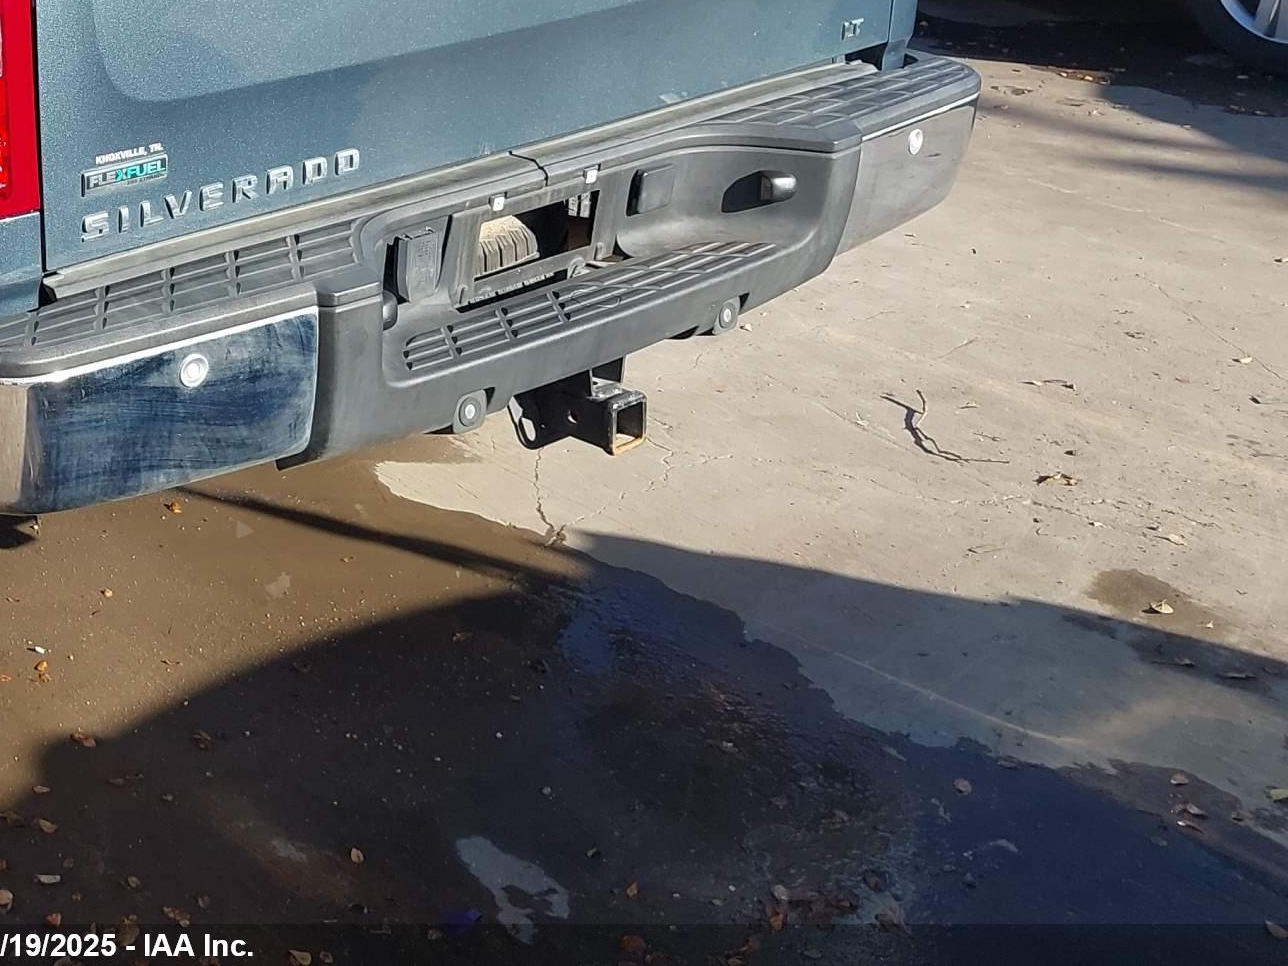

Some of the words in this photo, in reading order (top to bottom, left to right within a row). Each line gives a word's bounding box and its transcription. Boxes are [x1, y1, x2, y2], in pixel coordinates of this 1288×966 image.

[841, 18, 864, 42] LT
[95, 146, 148, 165] KNOXVILLE,
[81, 148, 360, 243] SILVERADO
